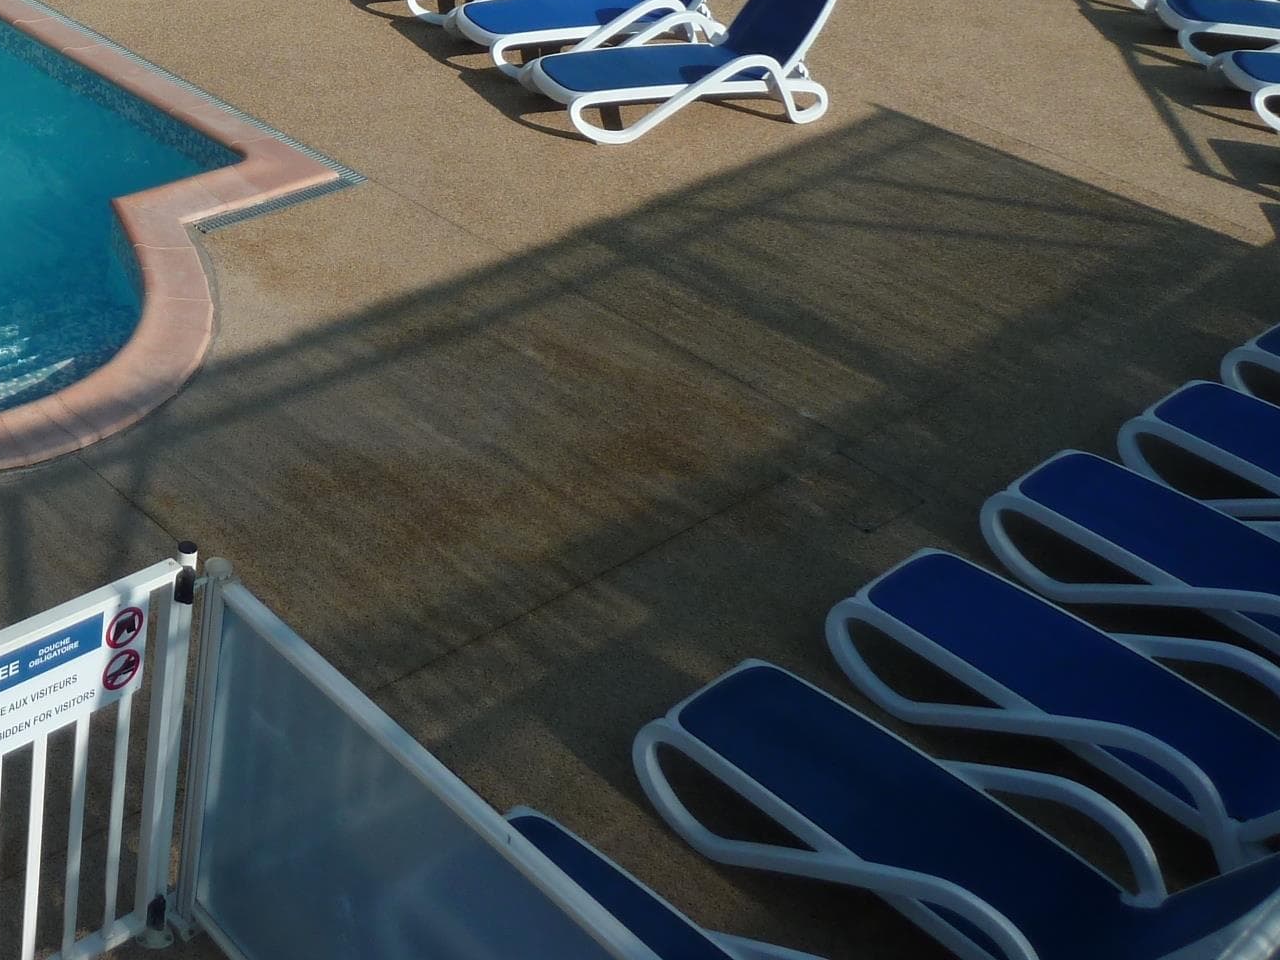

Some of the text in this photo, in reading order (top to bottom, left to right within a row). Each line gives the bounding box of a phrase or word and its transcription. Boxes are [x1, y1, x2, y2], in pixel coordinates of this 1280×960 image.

[28, 640, 79, 669] OBLIGATOIRE
[38, 636, 71, 656] DOUCHE
[8, 697, 29, 713] AUX
[30, 674, 78, 704] VISITEURS
[33, 709, 52, 725] FOR
[54, 689, 95, 715] VISITORS
